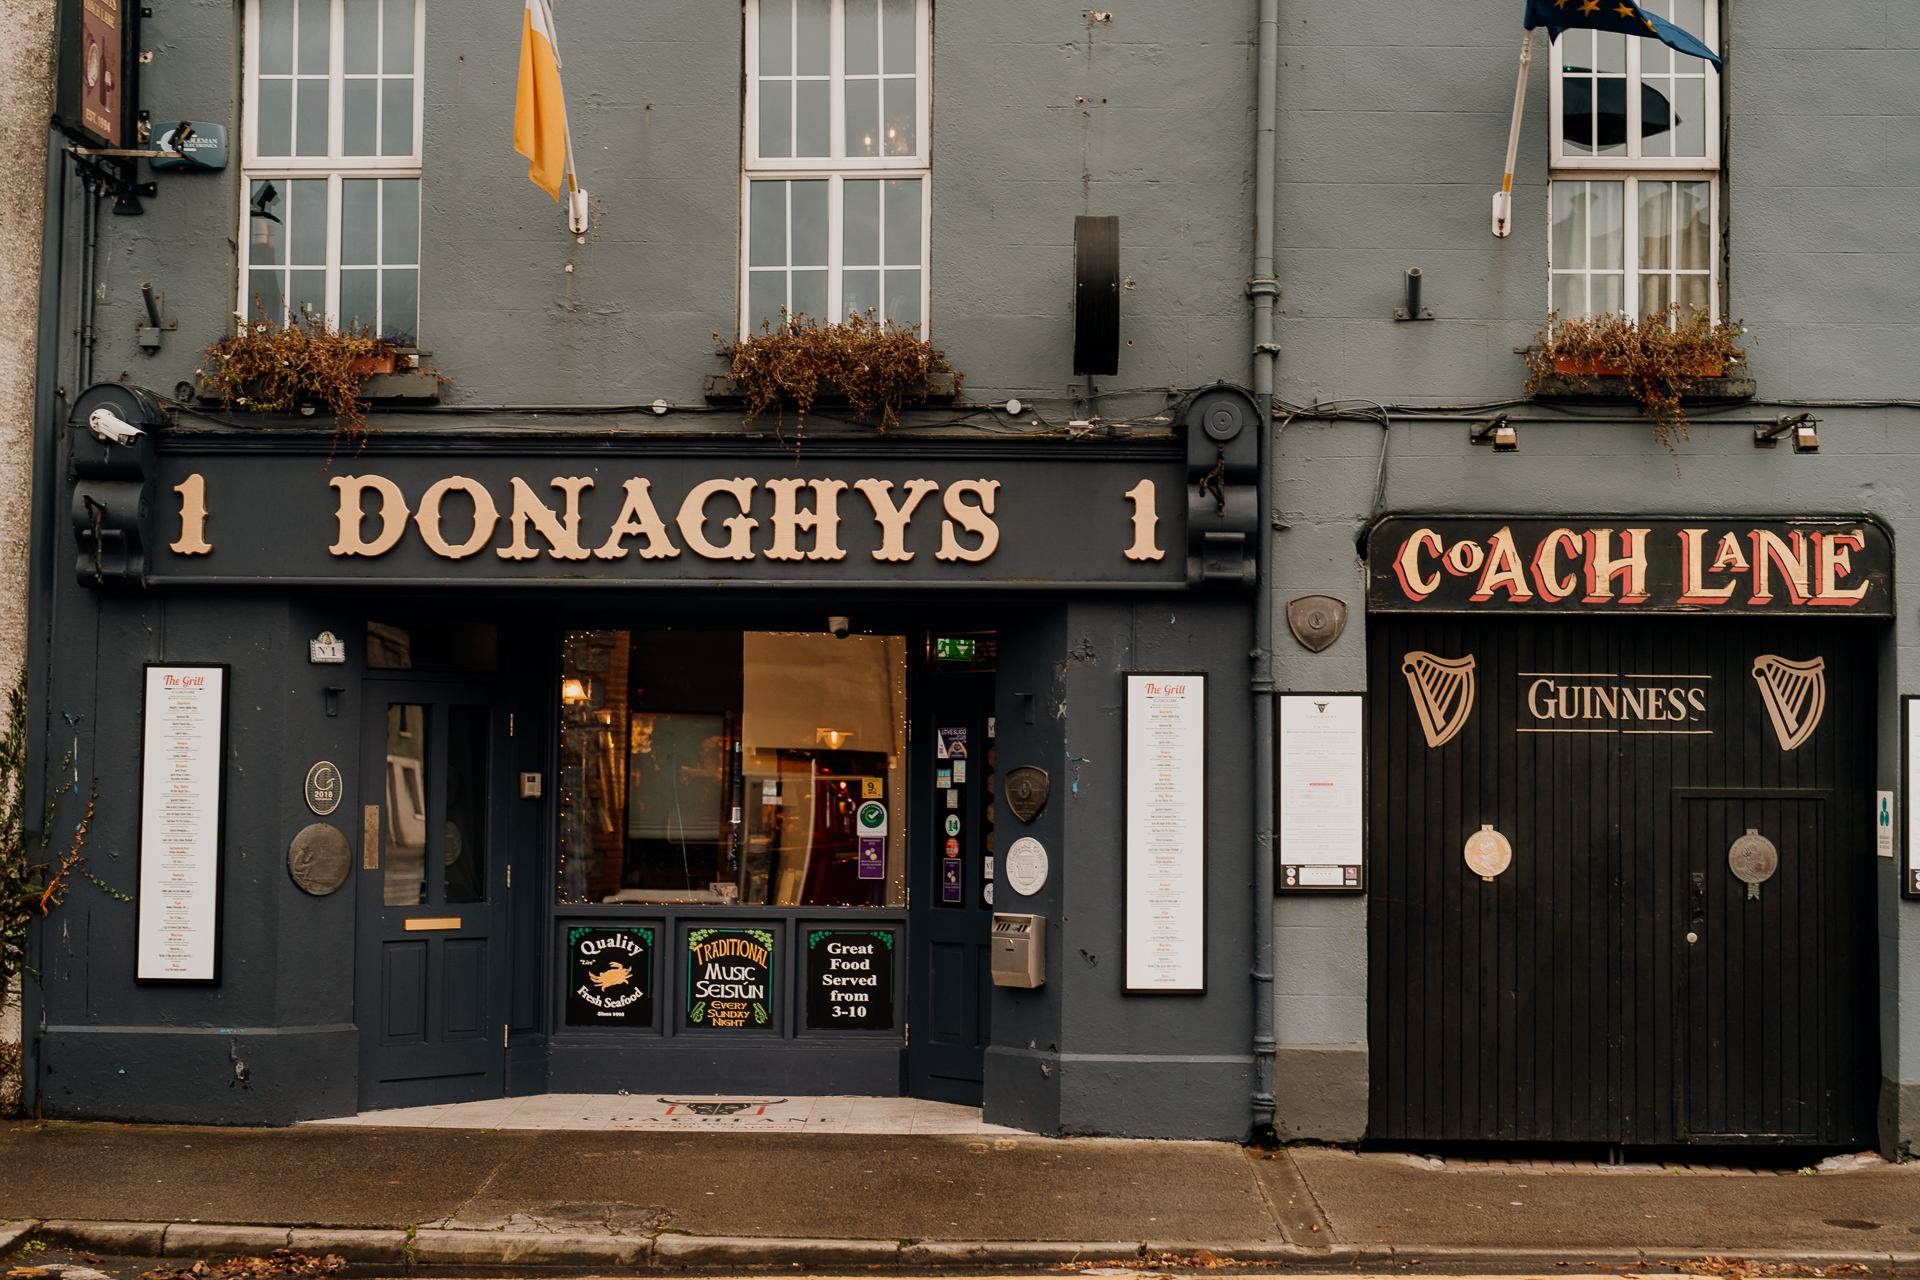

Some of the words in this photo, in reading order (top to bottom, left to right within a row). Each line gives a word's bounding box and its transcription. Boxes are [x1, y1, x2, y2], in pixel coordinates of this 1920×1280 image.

[169, 473, 212, 555] 1
[328, 474, 1001, 562] DONAGHYS
[1123, 479, 1166, 561] 1
[163, 674, 180, 686] The
[182, 675, 204, 688] Grill
[1144, 683, 1162, 694] The
[1164, 684, 1186, 696] Grill
[1527, 678, 1706, 722] GUINNESS
[314, 790, 333, 798] 2018
[948, 820, 958, 831] 14
[580, 933, 644, 957] Quality
[826, 942, 874, 955] Great
[692, 938, 768, 970] TRADITIONAL
[829, 958, 871, 970] Food
[822, 973, 878, 986] Served
[576, 984, 603, 1007] Fresh
[603, 986, 644, 1009] Seafood
[829, 989, 870, 1002] from
[710, 1000, 748, 1010] EVERY
[831, 1005, 867, 1018] 3-10
[706, 1008, 751, 1019] SUNDAY
[711, 1017, 746, 1027] NIGHT
